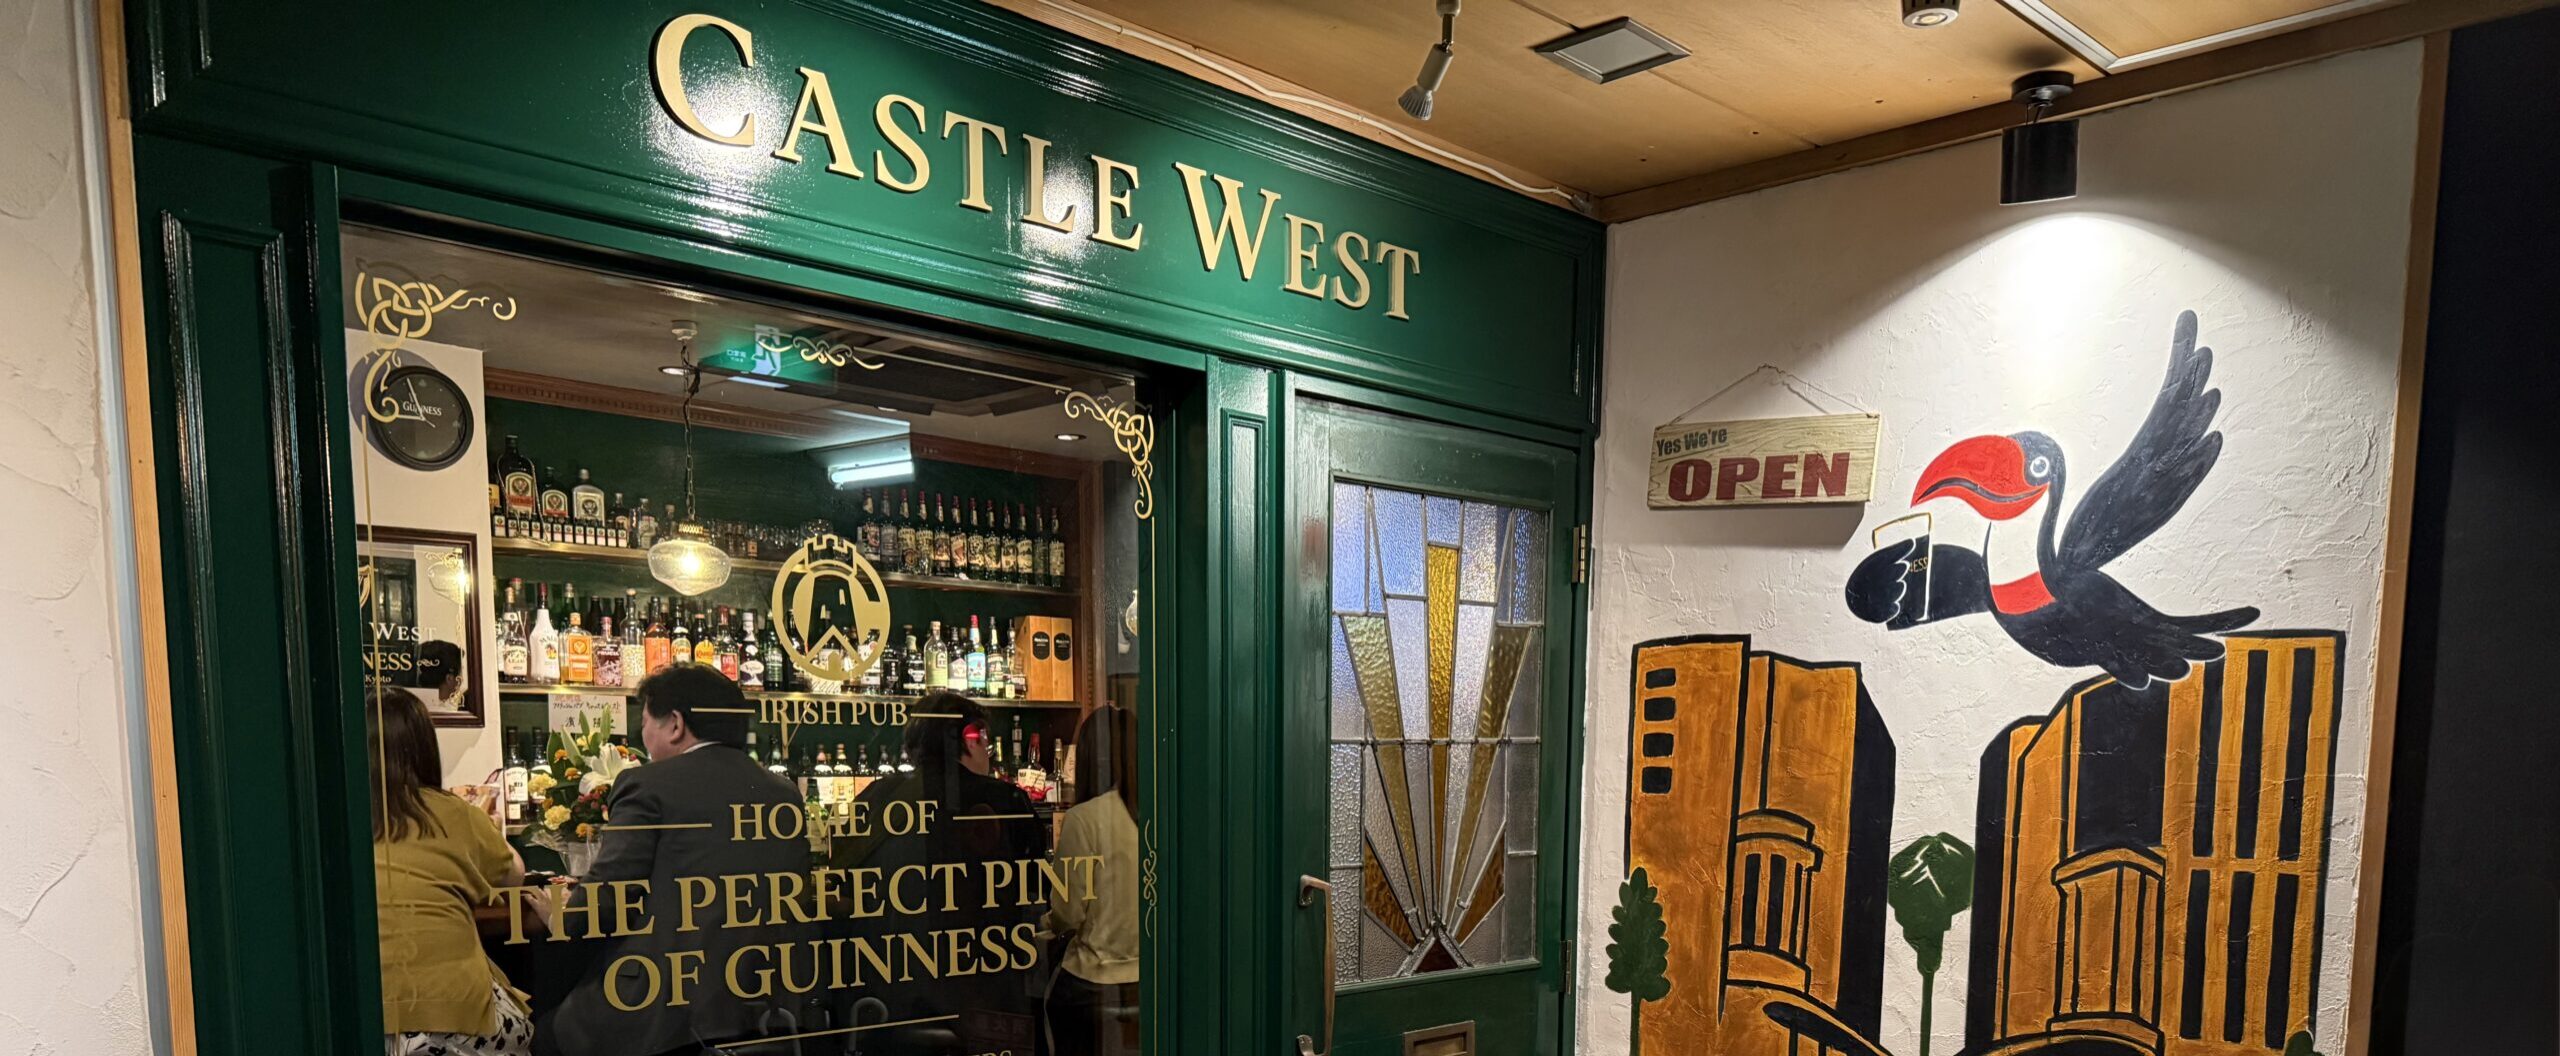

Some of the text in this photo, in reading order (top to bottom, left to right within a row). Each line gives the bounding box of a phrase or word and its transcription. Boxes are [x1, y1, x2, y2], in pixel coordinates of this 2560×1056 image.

[402, 400, 442, 417] GUNESS
[1656, 427, 1728, 457] Yes We're
[1667, 452, 1850, 502] OPEN
[758, 698, 909, 726] IRISH PUB
[729, 800, 939, 841] HOME OF
[488, 854, 1105, 945] THE PERFECT PINT
[604, 922, 1038, 1012] OF GUINNESS
